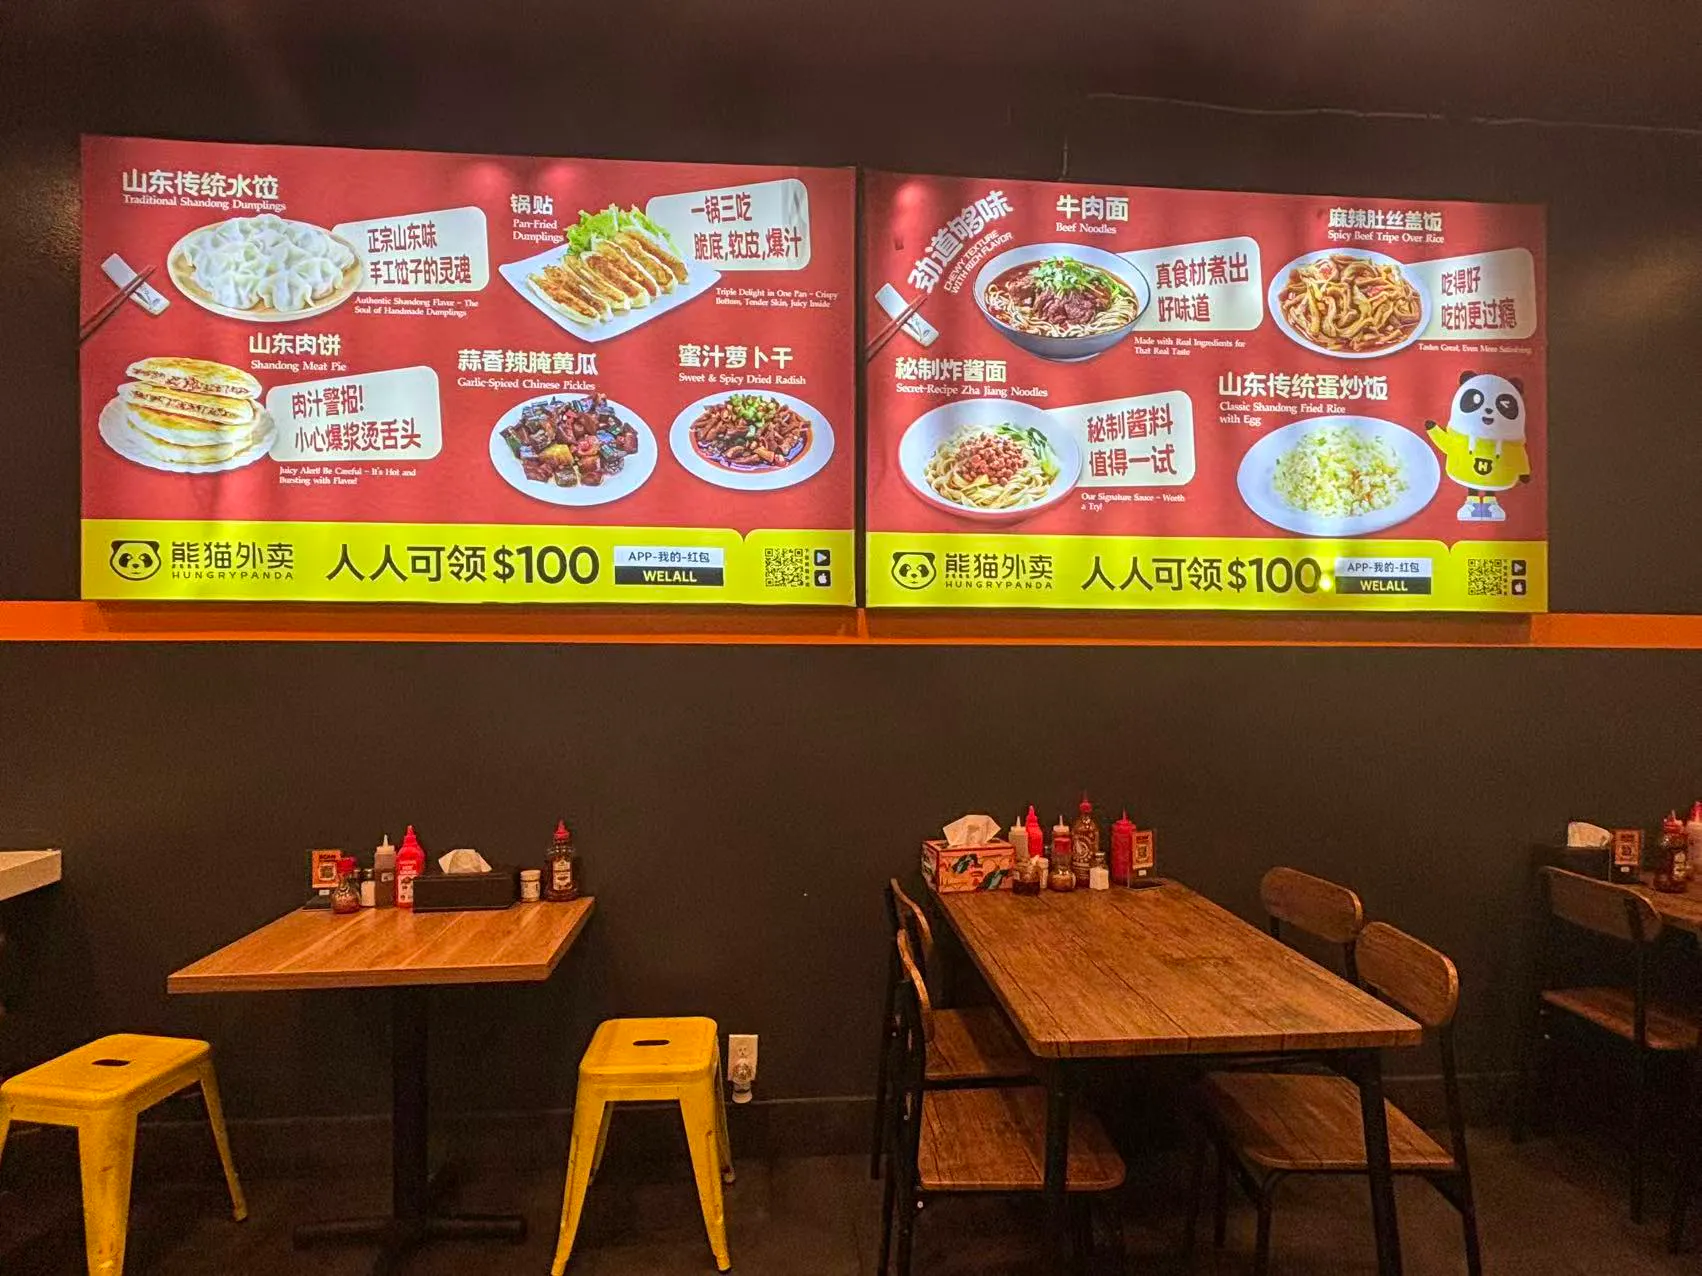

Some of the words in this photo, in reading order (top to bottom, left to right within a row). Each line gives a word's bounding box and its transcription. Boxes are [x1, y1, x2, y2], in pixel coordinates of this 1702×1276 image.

[122, 168, 279, 200] 山东传统水饺
[123, 194, 177, 206] Traditional
[179, 197, 229, 210] Shandong
[232, 199, 286, 213] Dumplings
[510, 193, 553, 215] 锅贴
[691, 192, 752, 224] 一锅三吃
[1056, 194, 1129, 222] 牛肉面
[513, 219, 557, 230] Pan-Fried
[1056, 222, 1077, 232] Beef
[1079, 223, 1117, 234] Noodles
[1328, 207, 1442, 232] 麻辣肚丝盖饭
[367, 220, 437, 253] 正宗山东味
[513, 231, 564, 243] Dumplings
[907, 190, 1014, 294] 劲道够味
[1328, 230, 1352, 241] Spicy
[1354, 231, 1374, 240] Beef
[1376, 232, 1399, 243] Tripe
[1402, 233, 1423, 242] Over
[1426, 234, 1445, 243] Rice
[370, 253, 472, 285] 手工饺子的灵魂
[944, 257, 966, 291] CHEWY
[964, 230, 999, 260] TEXTURE
[951, 271, 969, 294] WITH
[965, 253, 983, 272] RICH
[981, 232, 1014, 258] FLAVOR
[1155, 251, 1249, 289] 真食材煮出
[1441, 266, 1481, 296] 吃得好
[354, 296, 391, 304] Authentic
[393, 297, 430, 307] Shandong
[433, 298, 455, 307] Flavor
[464, 299, 478, 307] The
[716, 287, 737, 297] Triple
[738, 288, 765, 298] Delight
[767, 289, 774, 297] in
[777, 289, 791, 297] One
[794, 290, 807, 298] Pan
[815, 291, 839, 301] Crispy
[354, 306, 371, 314] Soul
[373, 306, 381, 314] of
[384, 307, 423, 315] Handmade
[426, 308, 467, 318] Dumplings
[745, 298, 768, 306] Tender
[770, 298, 788, 307] Skin,
[790, 299, 808, 309] Juicy
[810, 299, 831, 308] Inside
[1157, 293, 1210, 322] 好味道
[1441, 297, 1517, 330] 吃的更过瘾
[249, 332, 341, 356] 山东肉饼
[1134, 336, 1155, 345] Made
[1157, 337, 1173, 345] with
[1176, 338, 1191, 346] Real
[1194, 338, 1232, 349] Ingredients
[1235, 339, 1246, 348] for
[1135, 346, 1151, 355] That
[1153, 347, 1169, 355] Real
[1171, 347, 1190, 356] Taste
[1462, 344, 1478, 352] Even
[1480, 345, 1498, 353] More
[457, 348, 599, 376] 蒜香辣腌黄瓜
[678, 343, 793, 369] 蜜汁萝卜干
[251, 360, 299, 373] Shandong
[302, 361, 327, 371] Meat
[331, 362, 347, 371] Pie
[895, 357, 1007, 383] 秘制炸酱面
[457, 377, 519, 390] Garlic-Spiced
[522, 379, 560, 389] Chinese
[563, 380, 596, 390] Pickles
[678, 373, 705, 382] Sweet
[708, 374, 716, 382] &
[719, 374, 744, 385] Spicy
[746, 375, 771, 384] Dried
[775, 375, 806, 385] Radish
[1219, 371, 1388, 401] 山东传统蛋炒饭
[896, 383, 958, 396] Secret-Recipe
[961, 385, 980, 395] Zha
[983, 386, 1007, 398] Jiang
[1010, 387, 1048, 397] Noodles
[292, 384, 364, 419] 肉汁警报!
[1219, 401, 1250, 411] Classic
[1252, 402, 1297, 415] Shandong
[1301, 403, 1323, 413] Fried
[1327, 404, 1346, 414] Rice
[1087, 403, 1174, 443] 秘制酱料
[1219, 414, 1240, 423] with
[1243, 415, 1261, 426] Egg
[295, 418, 422, 453] 小心爆浆烫舌头
[1089, 444, 1177, 477] 值得一试
[1478, 461, 1488, 472] H
[279, 466, 297, 475] Juicy
[323, 467, 333, 475] Be
[335, 467, 362, 475] Careful
[385, 468, 400, 476] Hot
[402, 468, 416, 476] and
[279, 477, 310, 486] Bursting
[313, 477, 331, 485] with
[1081, 492, 1096, 501] Our
[1098, 492, 1132, 502] Signature
[1134, 493, 1154, 501] Sauce
[1163, 493, 1185, 502] Worth
[1089, 502, 1103, 512] Try!
[172, 541, 293, 569] 熊猫外卖
[628, 551, 710, 563] APP-我的-红包
[326, 544, 600, 585] 人人可领$100
[945, 553, 1053, 580] 熊猫外卖
[1347, 562, 1420, 573] APP-我的-红包
[172, 571, 293, 579] HUNGRYPANDA
[643, 570, 697, 582] WELALL
[1081, 556, 1322, 593] 人人可领$100
[945, 581, 1053, 589] HUNGRYPANDA
[1360, 580, 1408, 592] WELALL
